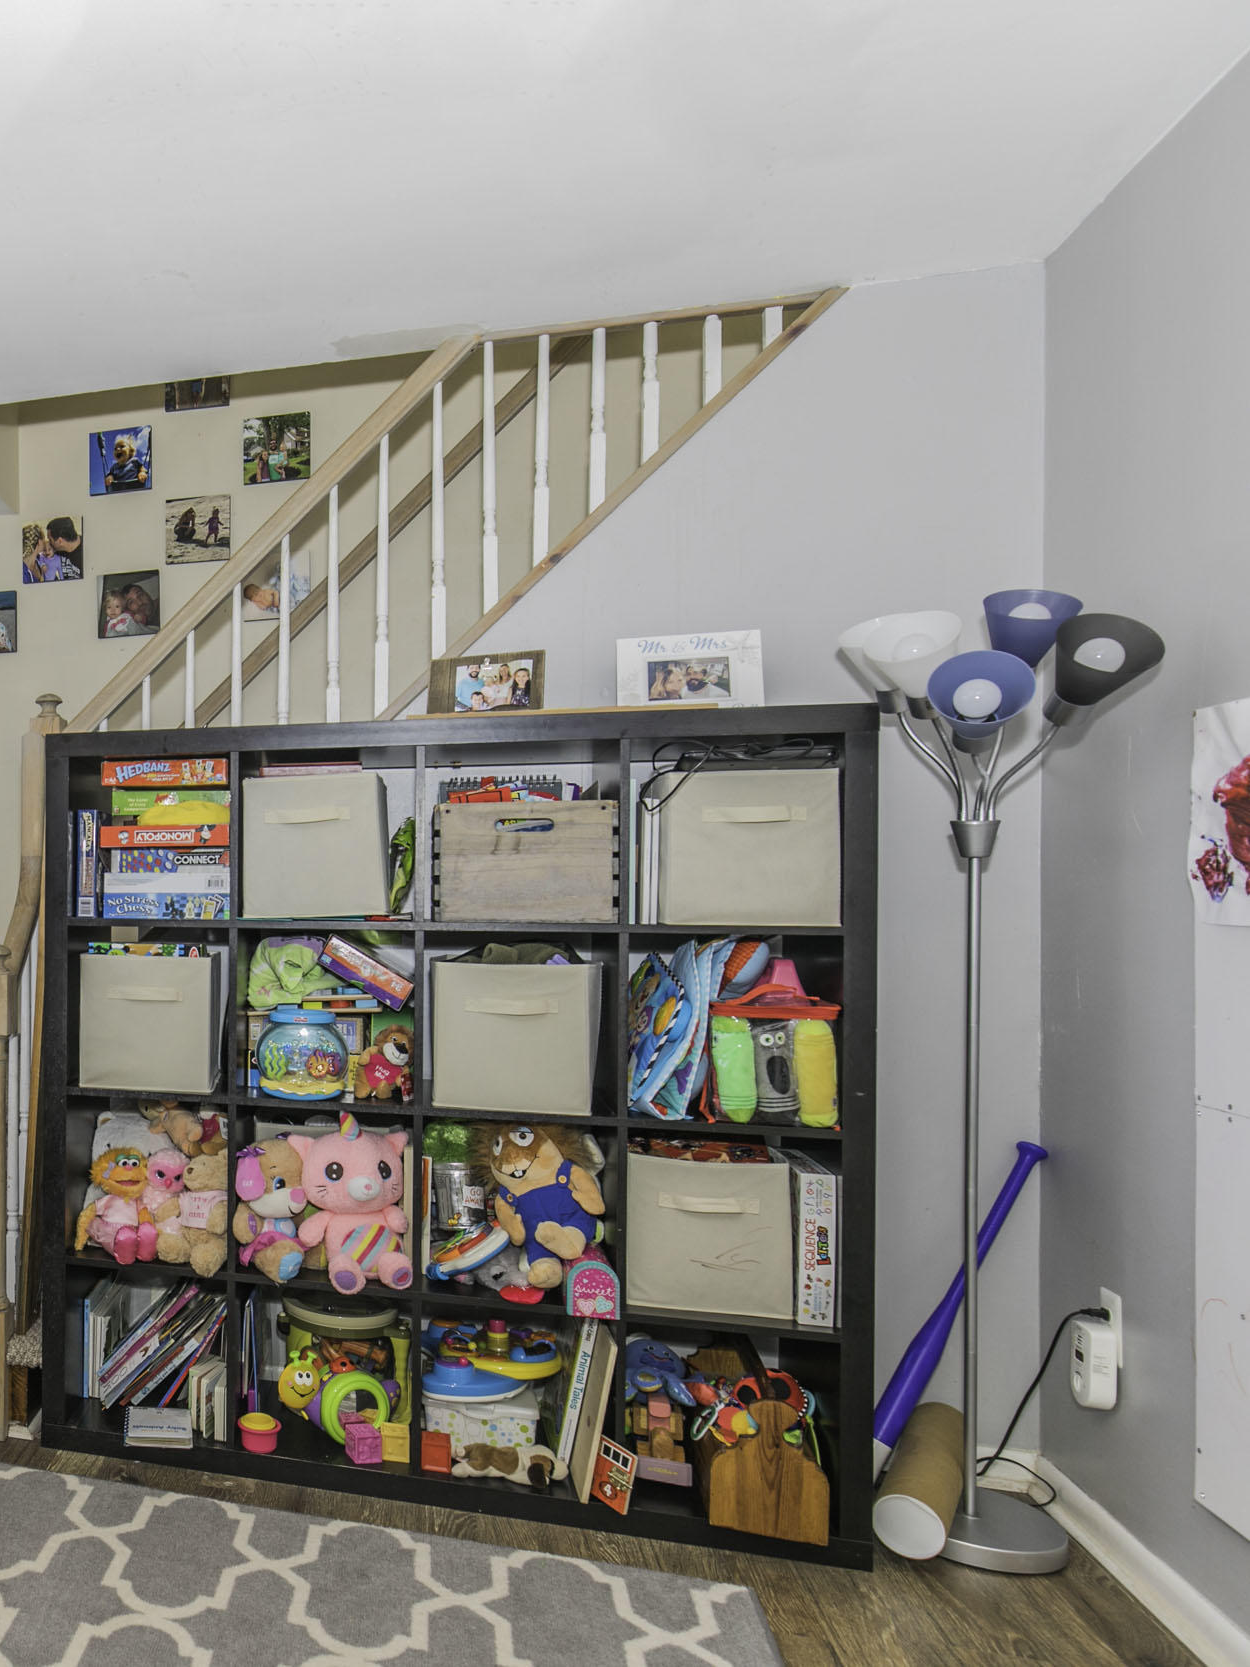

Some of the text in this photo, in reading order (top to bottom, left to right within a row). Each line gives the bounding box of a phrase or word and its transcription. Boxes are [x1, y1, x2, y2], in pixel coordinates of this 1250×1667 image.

[637, 639, 666, 654] Mr
[689, 636, 727, 651] Mrs
[115, 762, 172, 783] HEDBANZ
[136, 831, 192, 842] MONOPOLY
[174, 855, 220, 865] CONNECT
[107, 896, 123, 906] No
[116, 903, 152, 914] Chess
[374, 1064, 390, 1076] Hug
[470, 1188, 481, 1197] GO
[804, 1218, 817, 1272] SEQUENCE
[576, 1350, 591, 1382] Animal
[570, 1386, 584, 1410] Tales
[603, 1483, 613, 1498] 4
